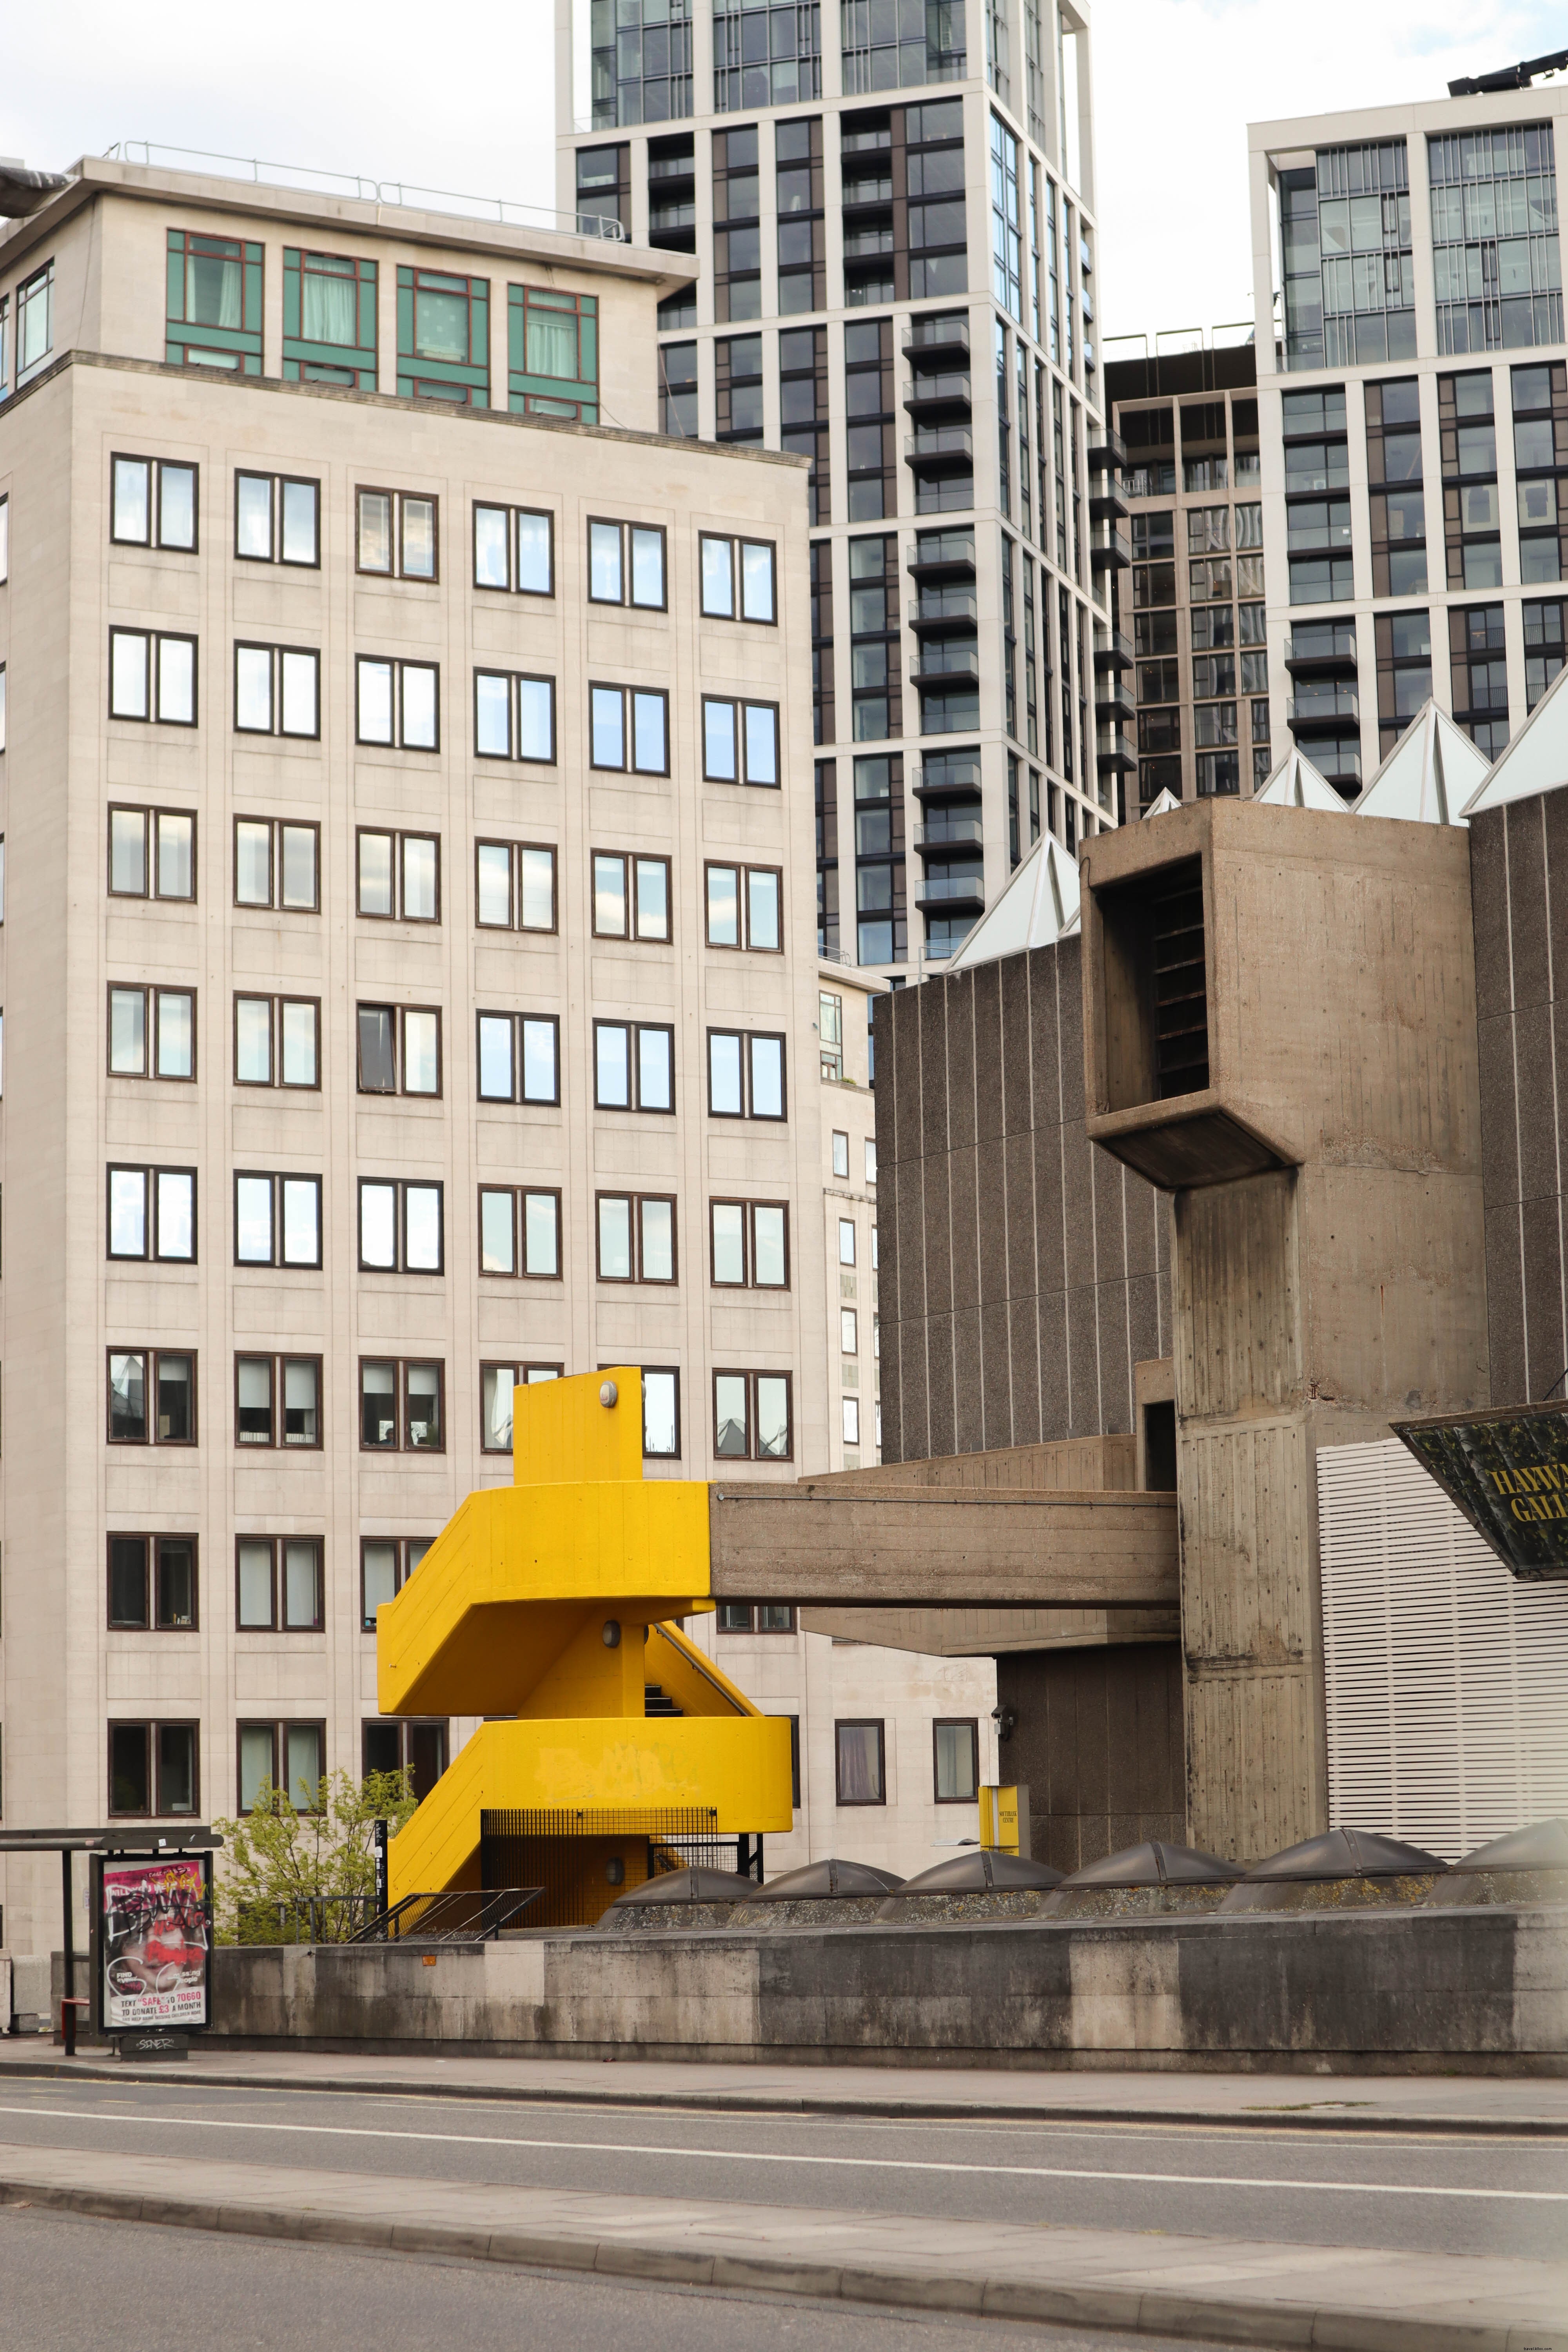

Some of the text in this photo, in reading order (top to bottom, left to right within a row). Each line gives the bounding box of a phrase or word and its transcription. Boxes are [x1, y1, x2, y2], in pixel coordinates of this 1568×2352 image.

[1511, 1494, 1568, 1522] GALL
[178, 1976, 198, 1985] eople
[177, 1991, 201, 2002] 70660
[132, 2007, 157, 2015] DONATE
[159, 2004, 169, 2013] £3
[178, 2001, 201, 2011] MONTH
